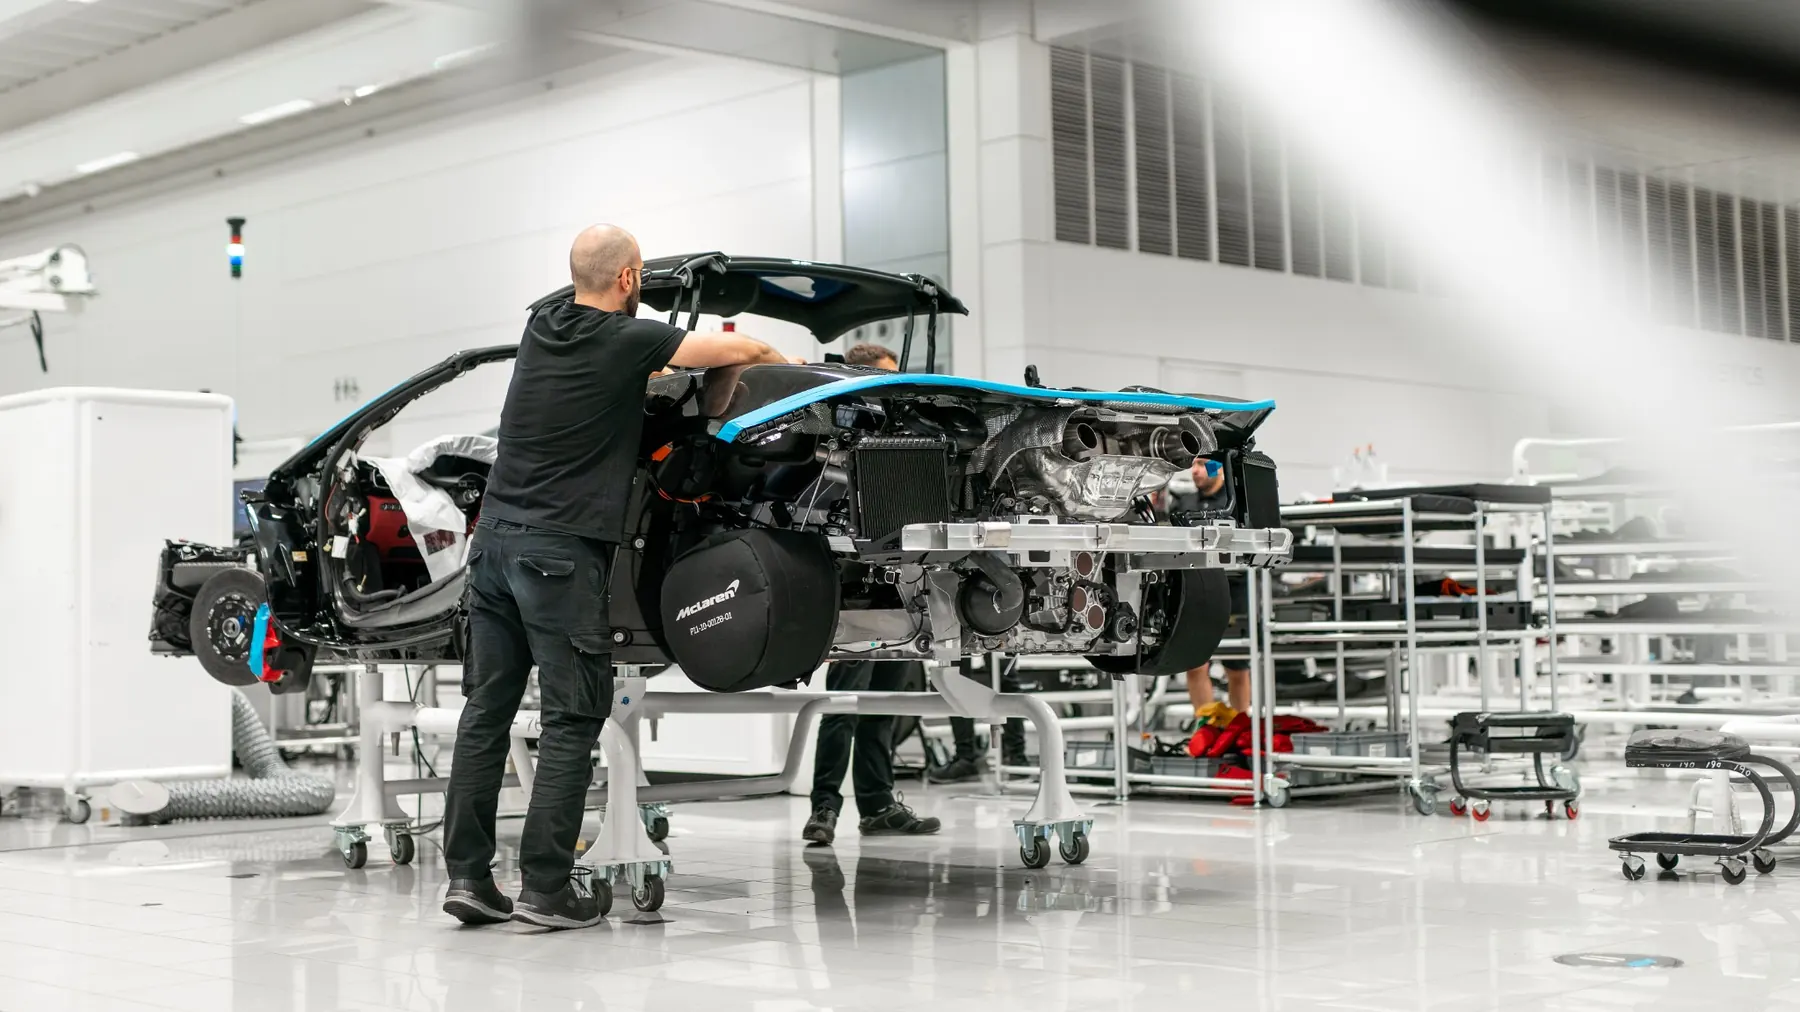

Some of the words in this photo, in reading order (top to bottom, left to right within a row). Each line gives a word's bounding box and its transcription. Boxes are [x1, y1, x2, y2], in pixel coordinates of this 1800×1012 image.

[675, 588, 736, 621] McLaren
[1705, 760, 1722, 768] 190
[1733, 764, 1751, 777] 190
